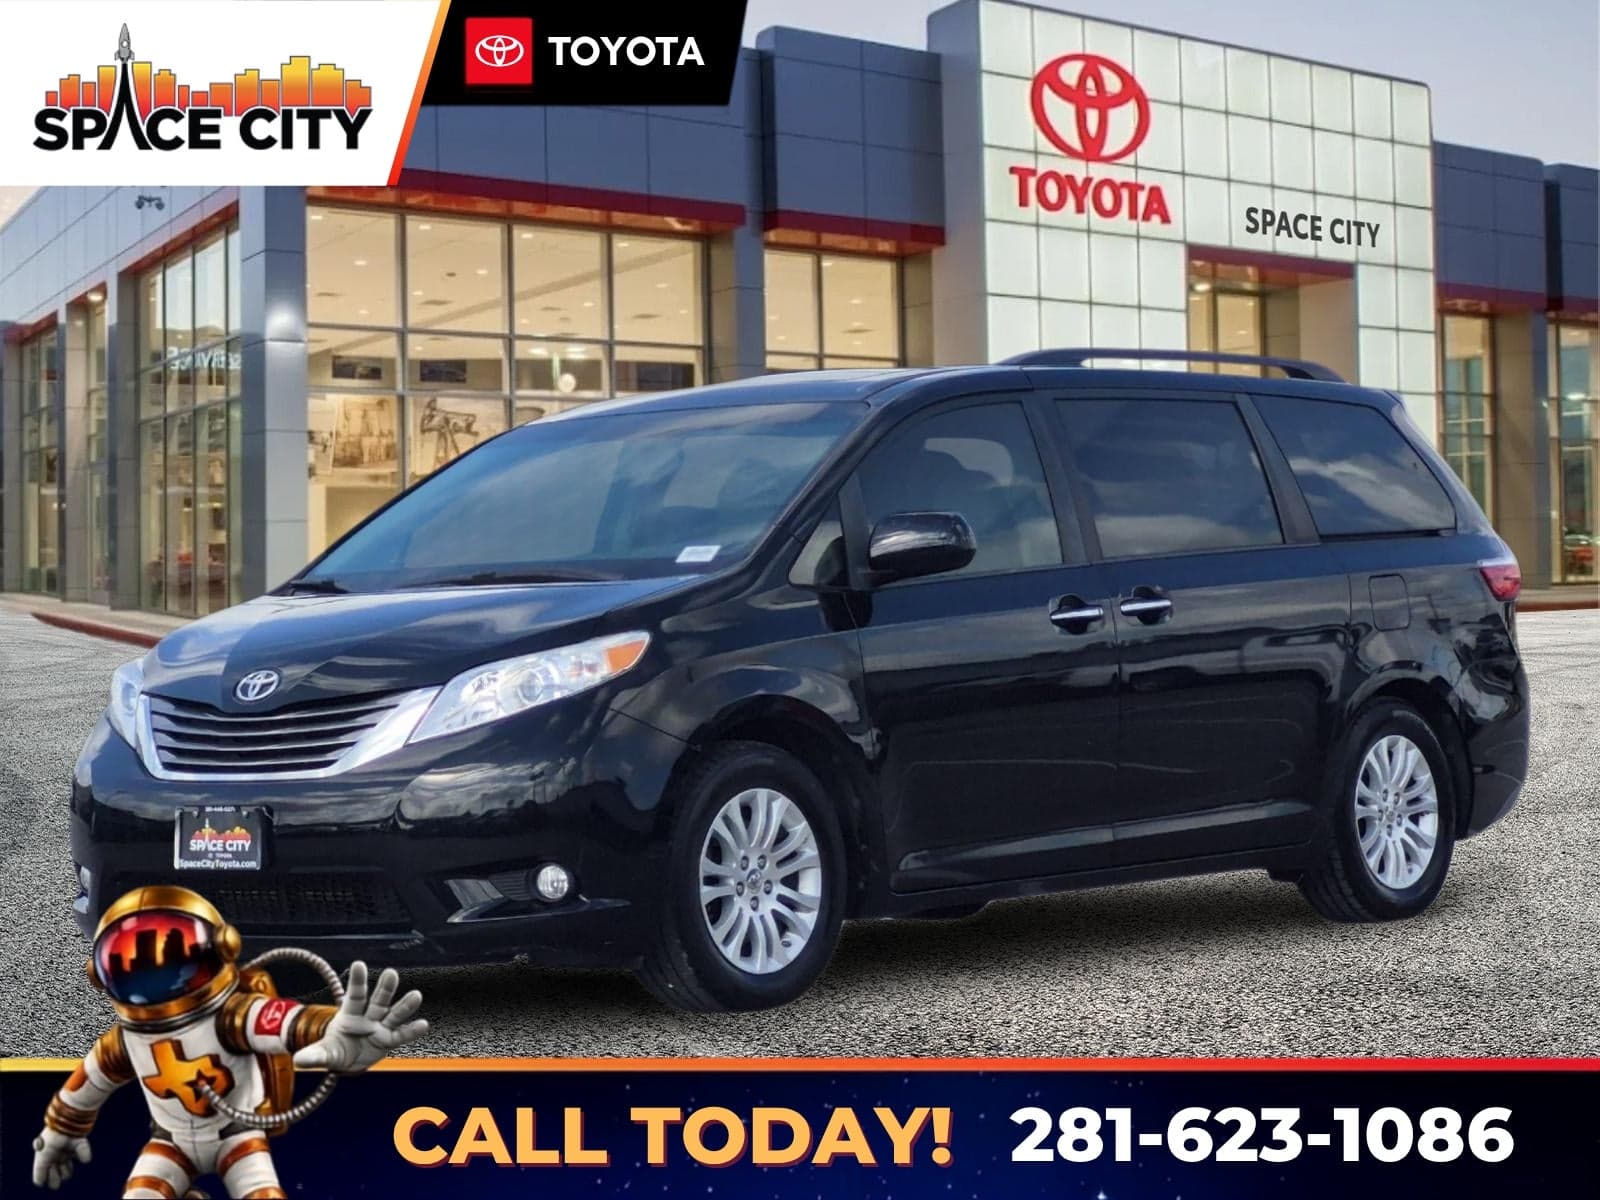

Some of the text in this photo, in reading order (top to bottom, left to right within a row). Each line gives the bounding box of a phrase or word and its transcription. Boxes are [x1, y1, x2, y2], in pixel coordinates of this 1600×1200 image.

[1009, 165, 1171, 224] TOYOTA
[1245, 206, 1381, 248] SPACE CITY
[189, 839, 251, 852] SPACE CITY
